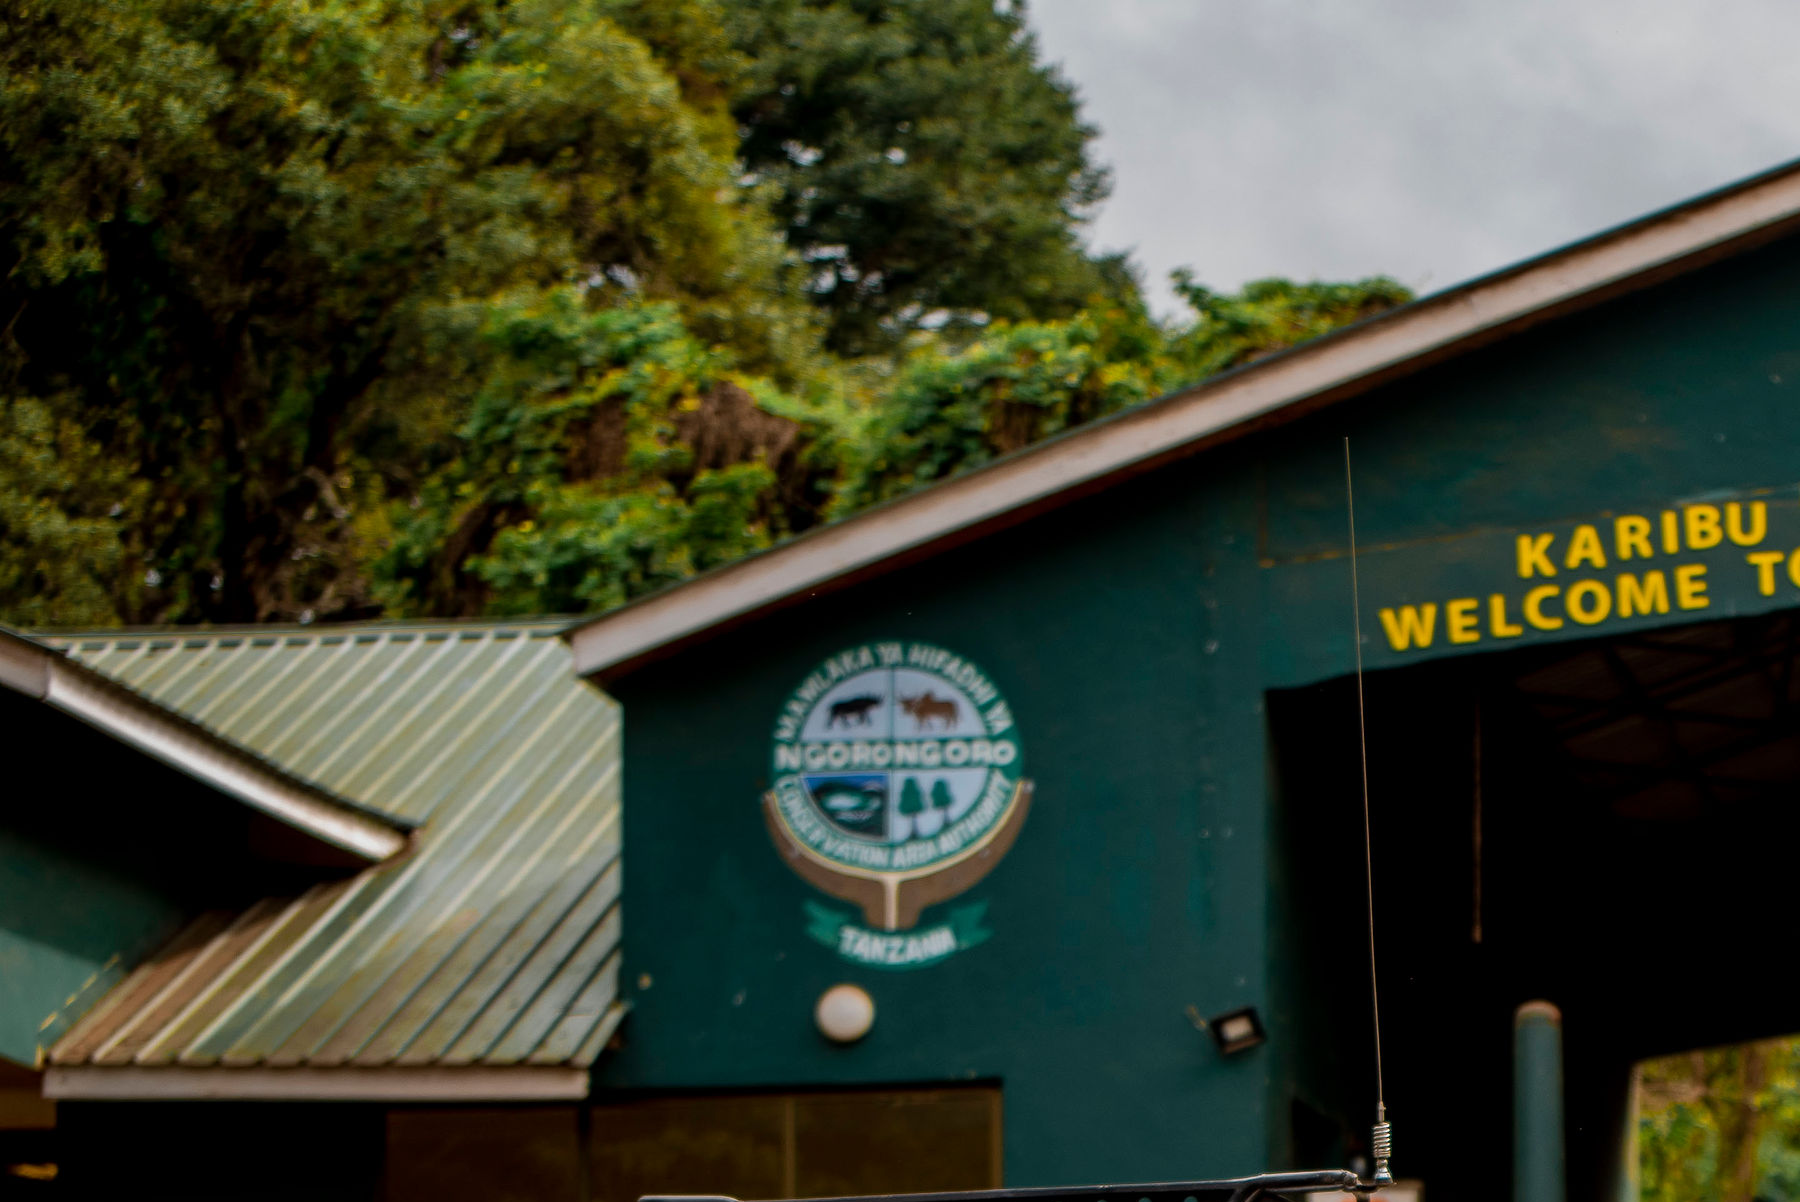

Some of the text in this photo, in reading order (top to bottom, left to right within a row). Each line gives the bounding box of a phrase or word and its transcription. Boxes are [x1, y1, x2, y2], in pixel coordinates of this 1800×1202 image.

[1515, 500, 1767, 579] KARIBU
[1378, 563, 1710, 652] WELCOME
[773, 740, 1016, 770] NGORONGORO
